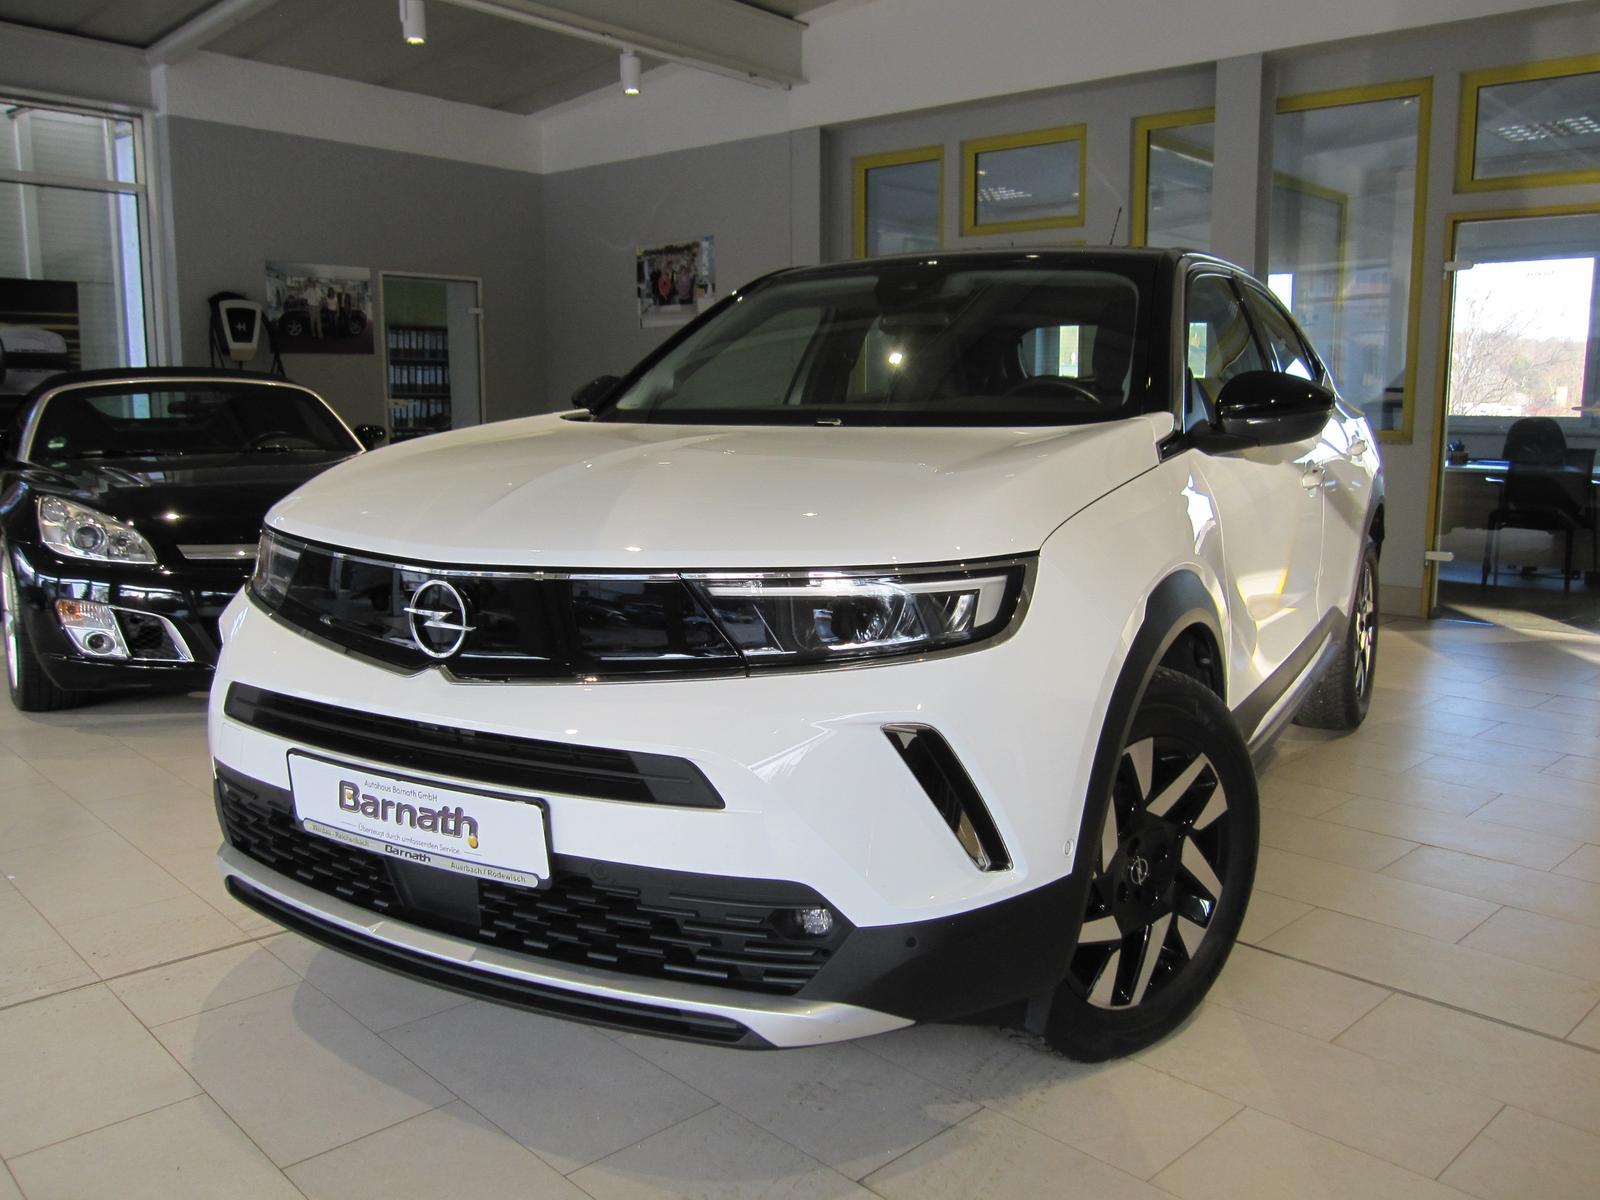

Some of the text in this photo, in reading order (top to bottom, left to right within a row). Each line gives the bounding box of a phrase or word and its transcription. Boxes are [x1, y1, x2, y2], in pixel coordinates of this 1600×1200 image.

[418, 791, 438, 802] GmbH
[339, 780, 479, 849] Barnath
[384, 844, 431, 863] Barnath
[439, 843, 461, 854] Service
[487, 869, 526, 884] Rodewisch
